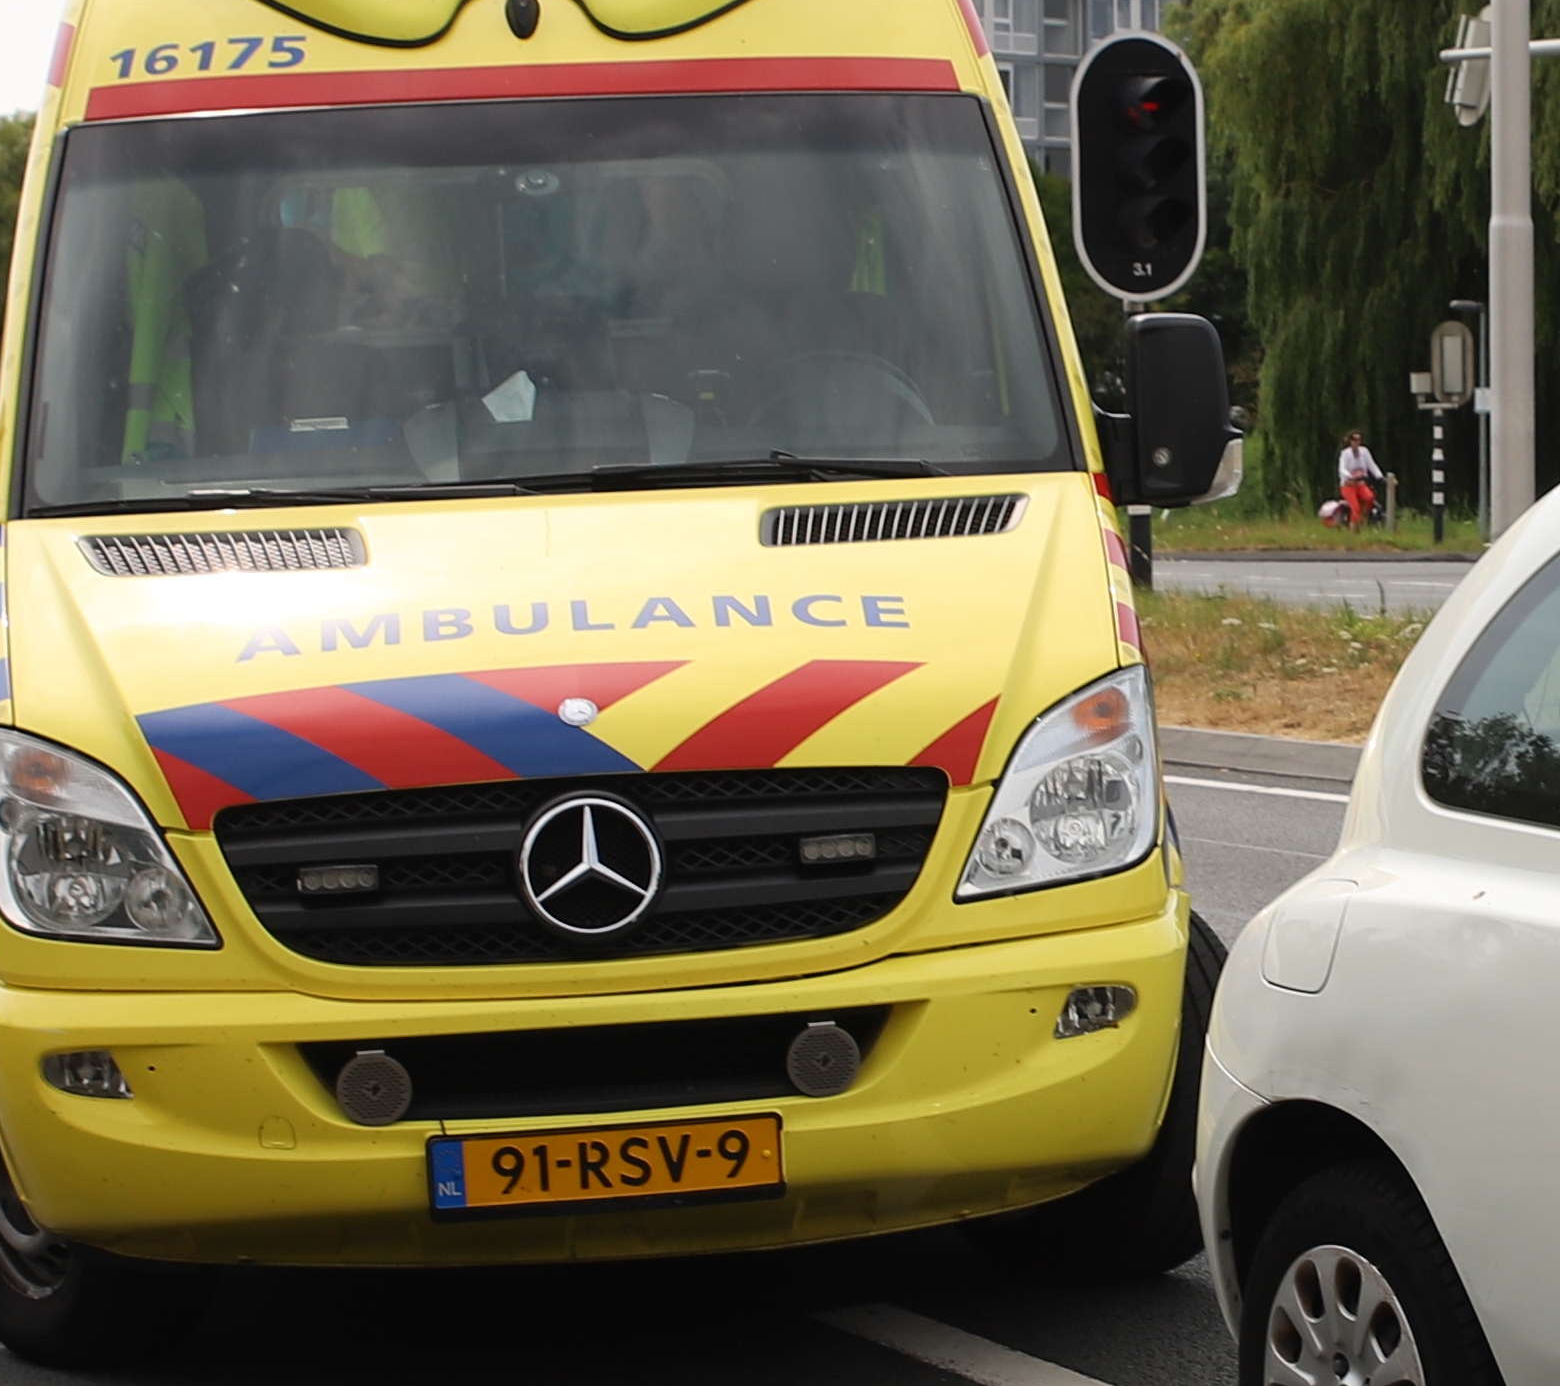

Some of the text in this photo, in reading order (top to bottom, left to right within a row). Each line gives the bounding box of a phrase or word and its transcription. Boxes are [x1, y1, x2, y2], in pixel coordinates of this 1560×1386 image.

[110, 36, 307, 79] 16175
[1132, 261, 1153, 277] 3.1
[235, 594, 912, 663] AMBULANCE
[492, 1128, 750, 1195] 91-RSV-9
[438, 1181, 462, 1197] NL
